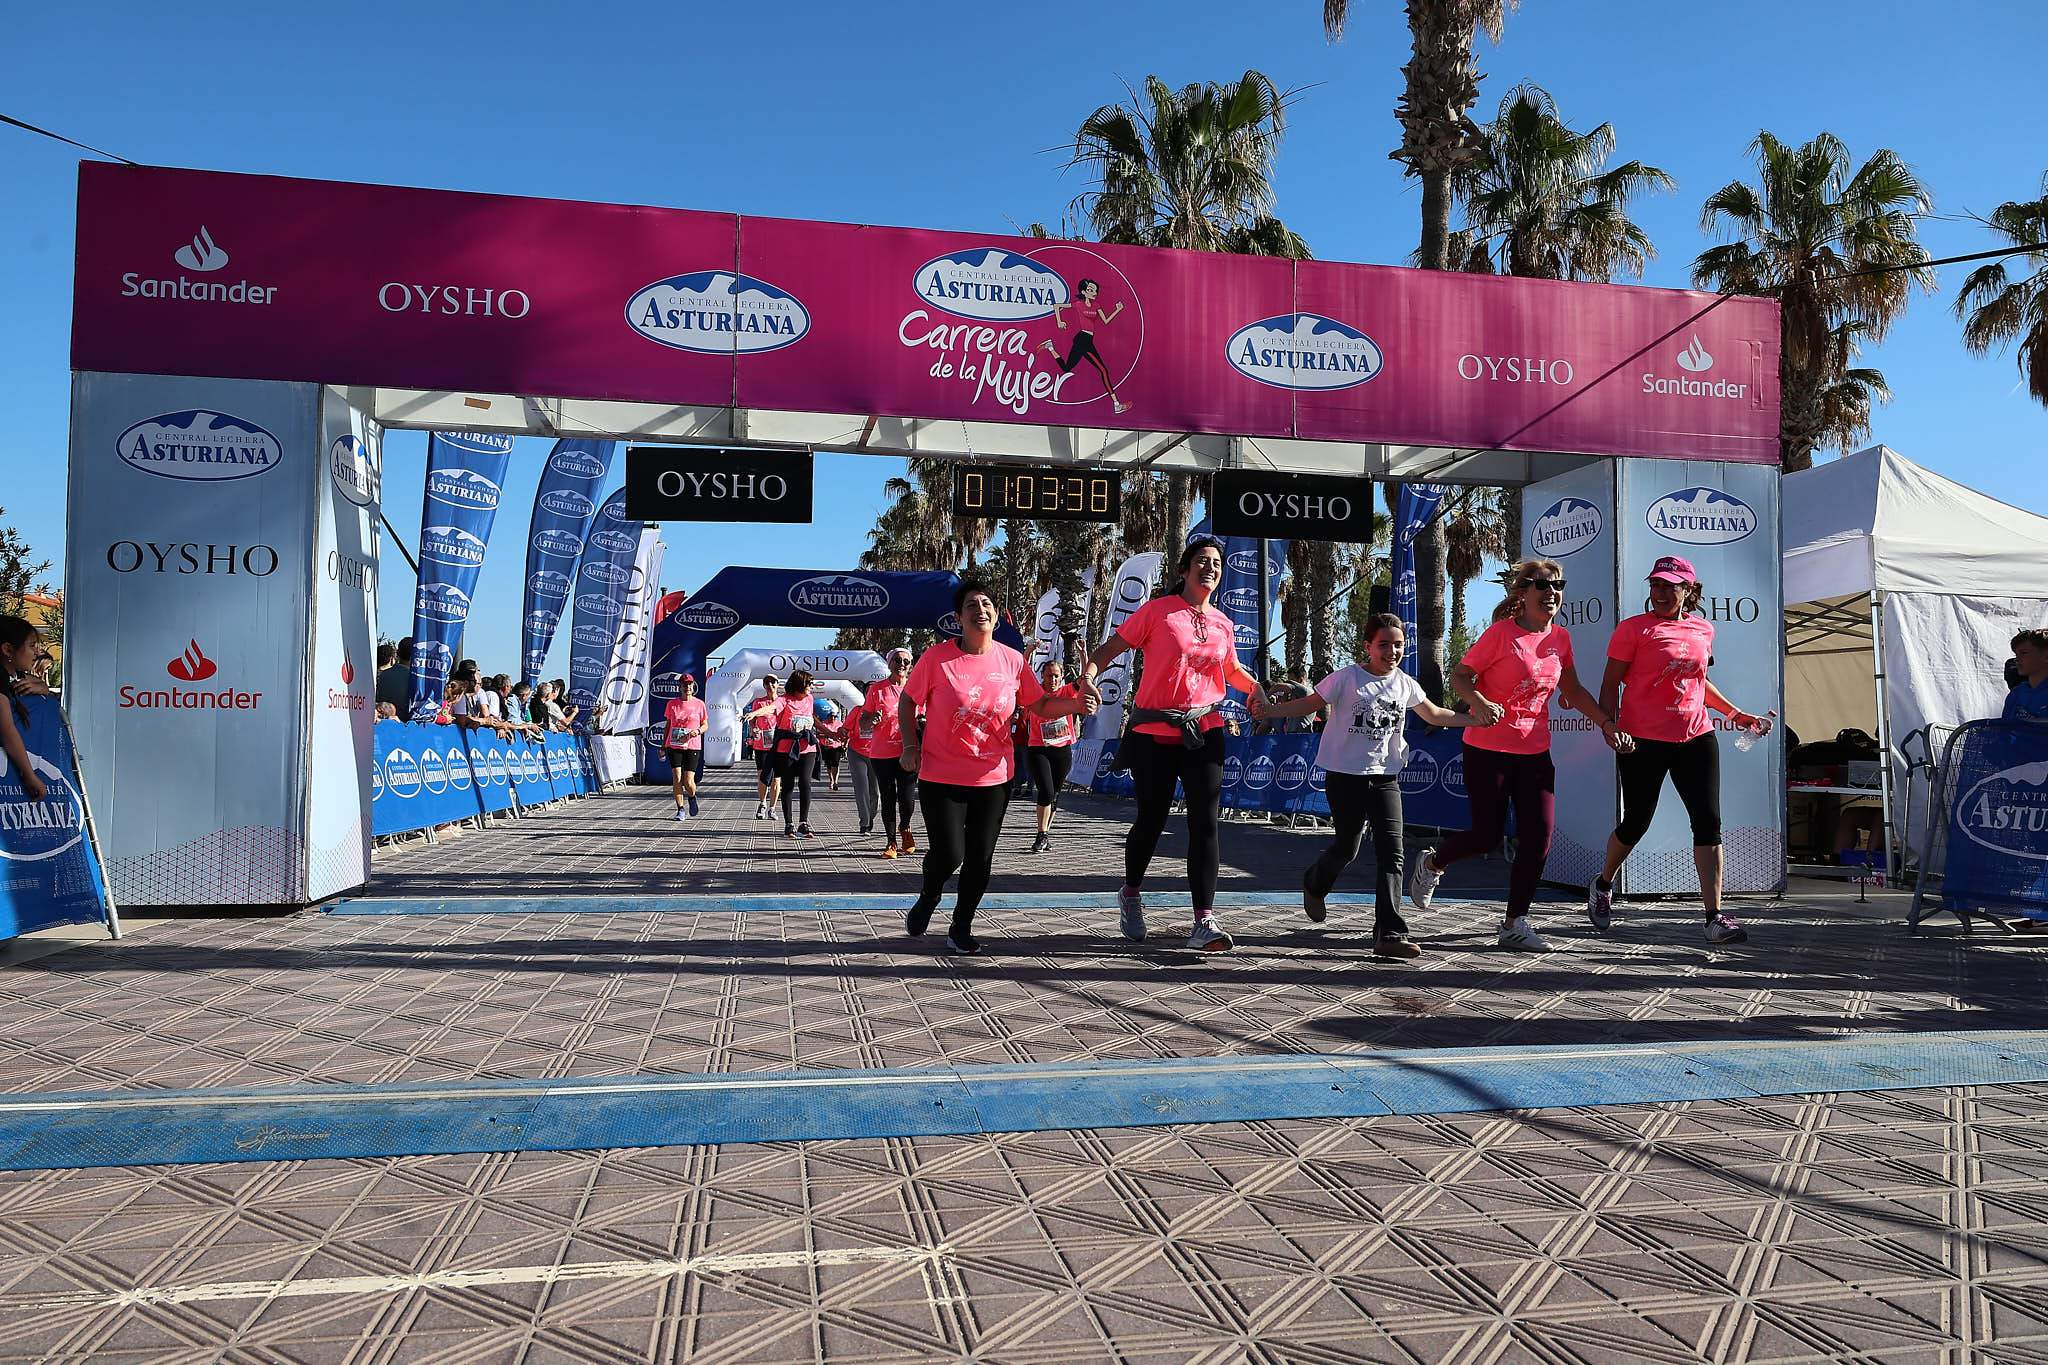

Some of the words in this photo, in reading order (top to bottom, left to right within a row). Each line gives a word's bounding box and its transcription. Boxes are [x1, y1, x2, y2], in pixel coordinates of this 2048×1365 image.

[121, 272, 278, 305] Santander
[926, 270, 1056, 306] ASTURIANA
[950, 269, 1000, 281] CENTRAL
[1004, 275, 1053, 286] LECHERA
[378, 282, 530, 319] OYSHO
[669, 296, 728, 308] CENTRAL
[639, 296, 796, 336] ASTURIANA
[898, 310, 1029, 356] Carrera
[1262, 336, 1312, 348] CENTRAL
[1316, 340, 1366, 351] LECHERA
[1238, 337, 1372, 373] ASTURIANA
[1457, 354, 1574, 385] OYSHO
[929, 352, 954, 378] de
[959, 353, 976, 381] la
[971, 353, 1075, 415] Mujer
[1642, 373, 1748, 399] Santander
[128, 433, 271, 466] ASTURIANA
[155, 432, 208, 443] CENTRAL
[213, 434, 266, 444] LECHERA
[657, 470, 788, 501] OYSHO
[1239, 491, 1351, 521] OYSHO
[1654, 506, 1749, 532] ASTURIANA
[1535, 519, 1597, 549] ASTURIANA
[107, 540, 279, 577] OYSHO
[328, 551, 373, 593] OYSHO
[796, 586, 882, 607] ASTURIANA
[679, 611, 734, 625] ASTURIANA
[769, 655, 849, 673] OYSHO
[119, 686, 263, 710] Santander
[328, 688, 366, 711] Santander
[1400, 770, 1434, 783] STURIANA
